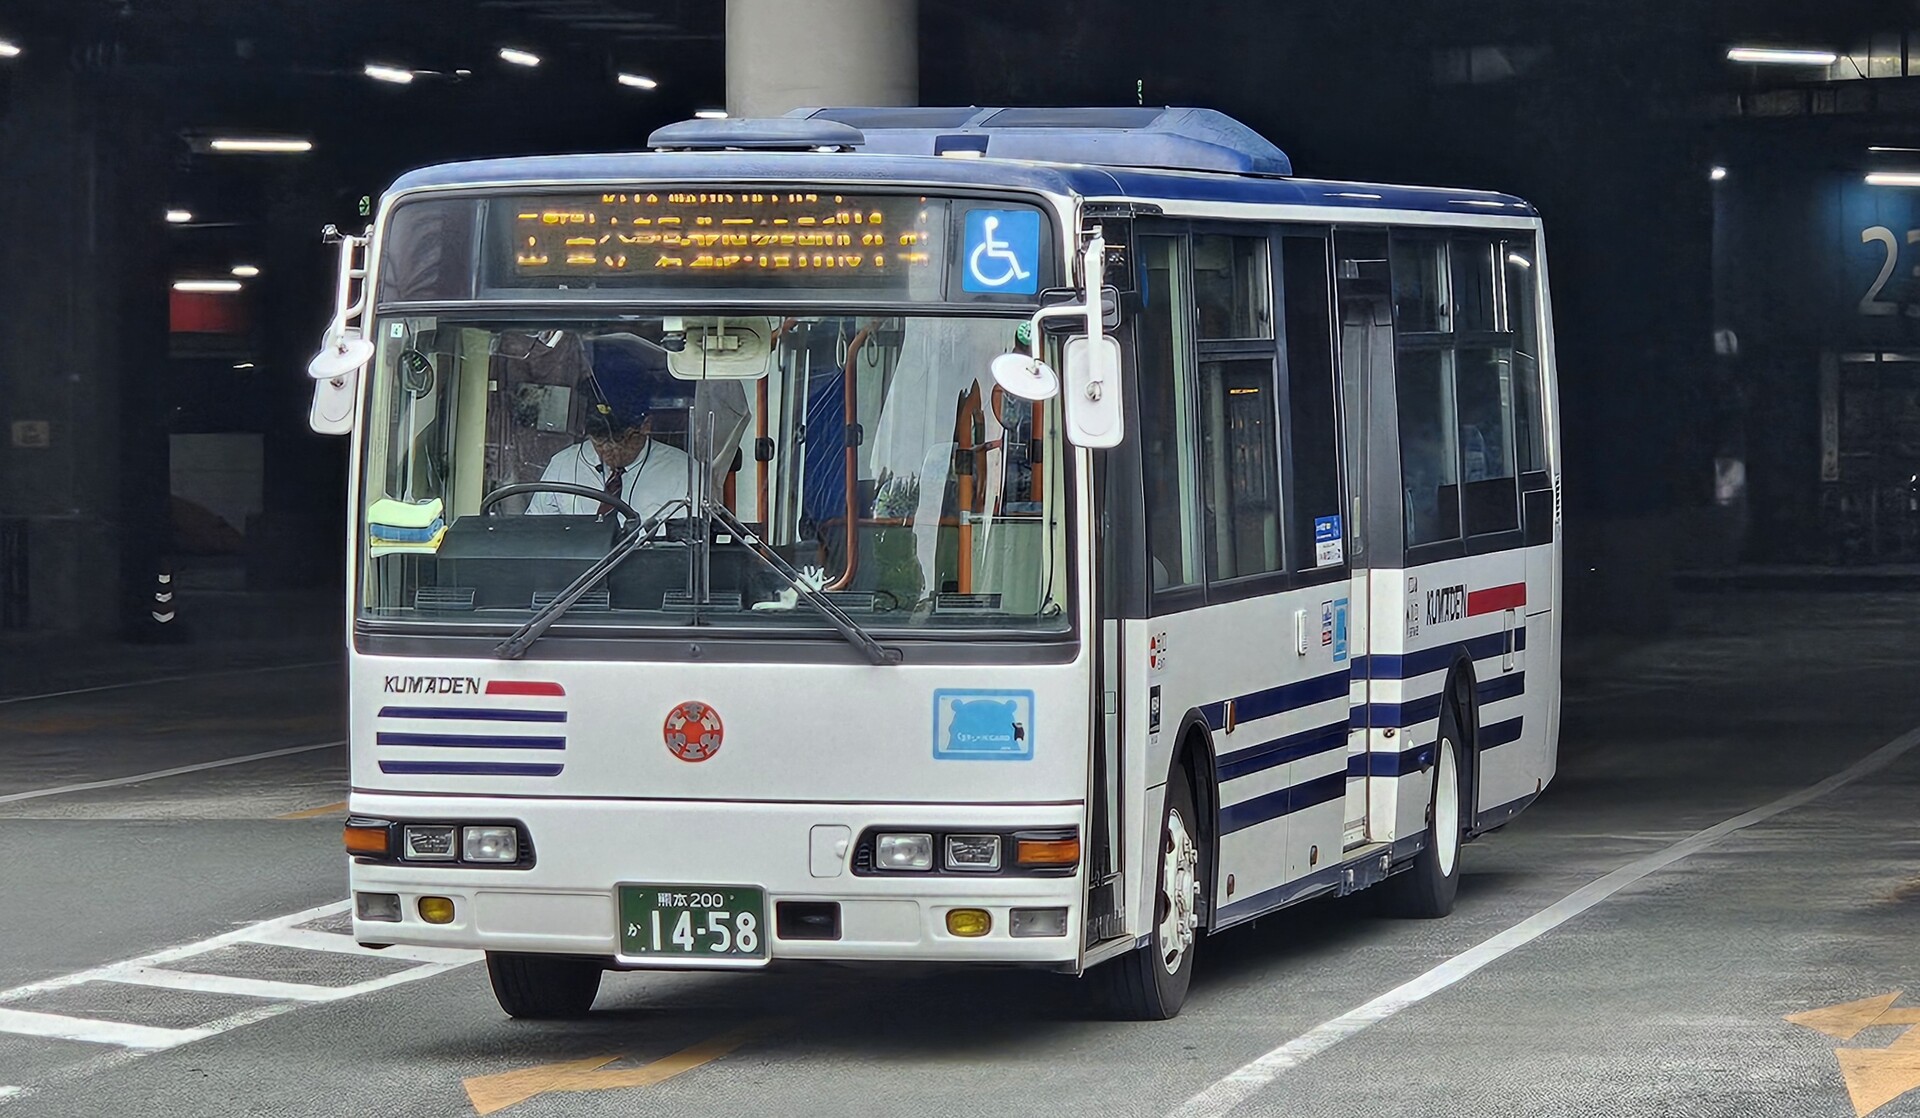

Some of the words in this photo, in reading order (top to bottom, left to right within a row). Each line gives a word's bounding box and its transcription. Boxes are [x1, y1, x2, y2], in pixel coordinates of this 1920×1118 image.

[384, 675, 481, 694] KUMADEN
[627, 922, 642, 937] か
[651, 910, 758, 953] 14-58
